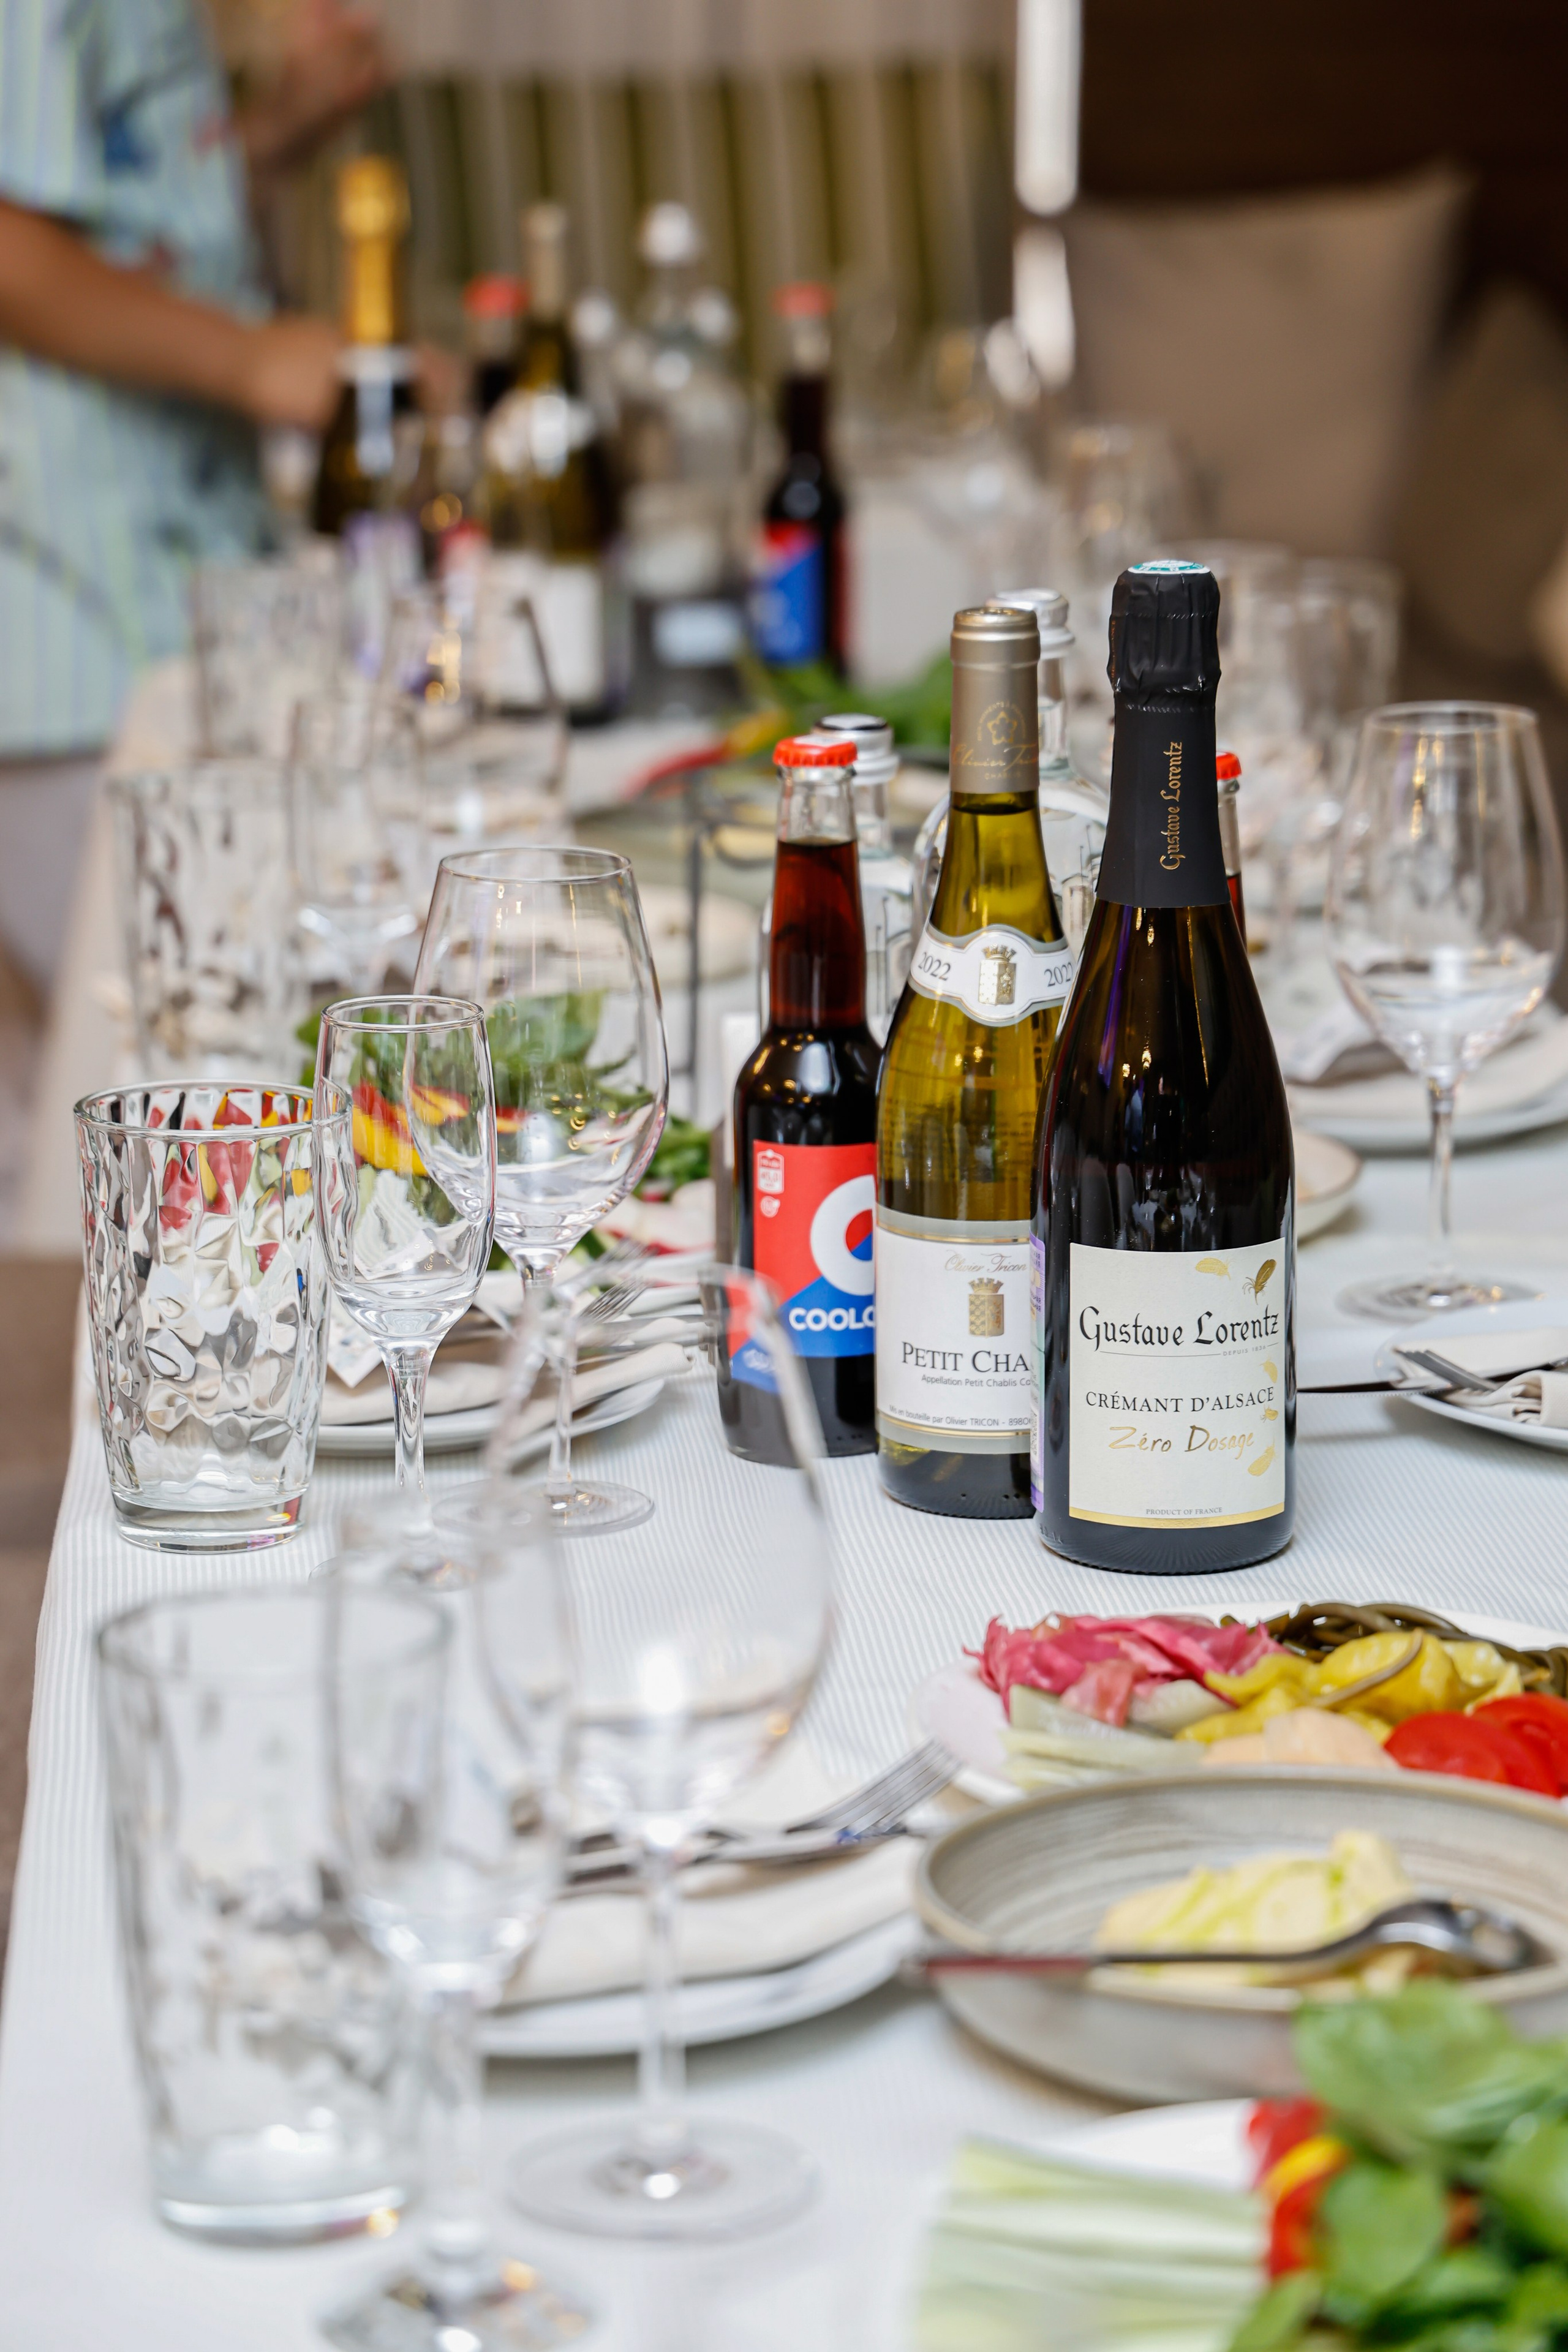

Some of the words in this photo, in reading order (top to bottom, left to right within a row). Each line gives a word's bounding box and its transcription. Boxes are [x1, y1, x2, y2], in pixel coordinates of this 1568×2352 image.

[1160, 741, 1182, 802] Lorentz
[1159, 806, 1186, 870] Gustave
[918, 952, 951, 981] 2022
[981, 1253, 1027, 1273] Tricon
[1079, 1306, 1184, 1352] Gustave
[1193, 1304, 1279, 1344] Lorentz
[902, 1341, 963, 1371] PETIT
[921, 1374, 962, 1386] Appellation
[965, 1378, 984, 1387] Petit
[986, 1378, 1017, 1387] Chablis
[1086, 1391, 1183, 1412] CRÉMANT
[1191, 1387, 1274, 1412] D'ALSACE
[906, 1409, 930, 1422] bouteille
[945, 1416, 968, 1425] Olivier
[1008, 1417, 1030, 1426] 8980
[1109, 1426, 1172, 1452] Zéro
[1185, 1425, 1254, 1460] Dosage
